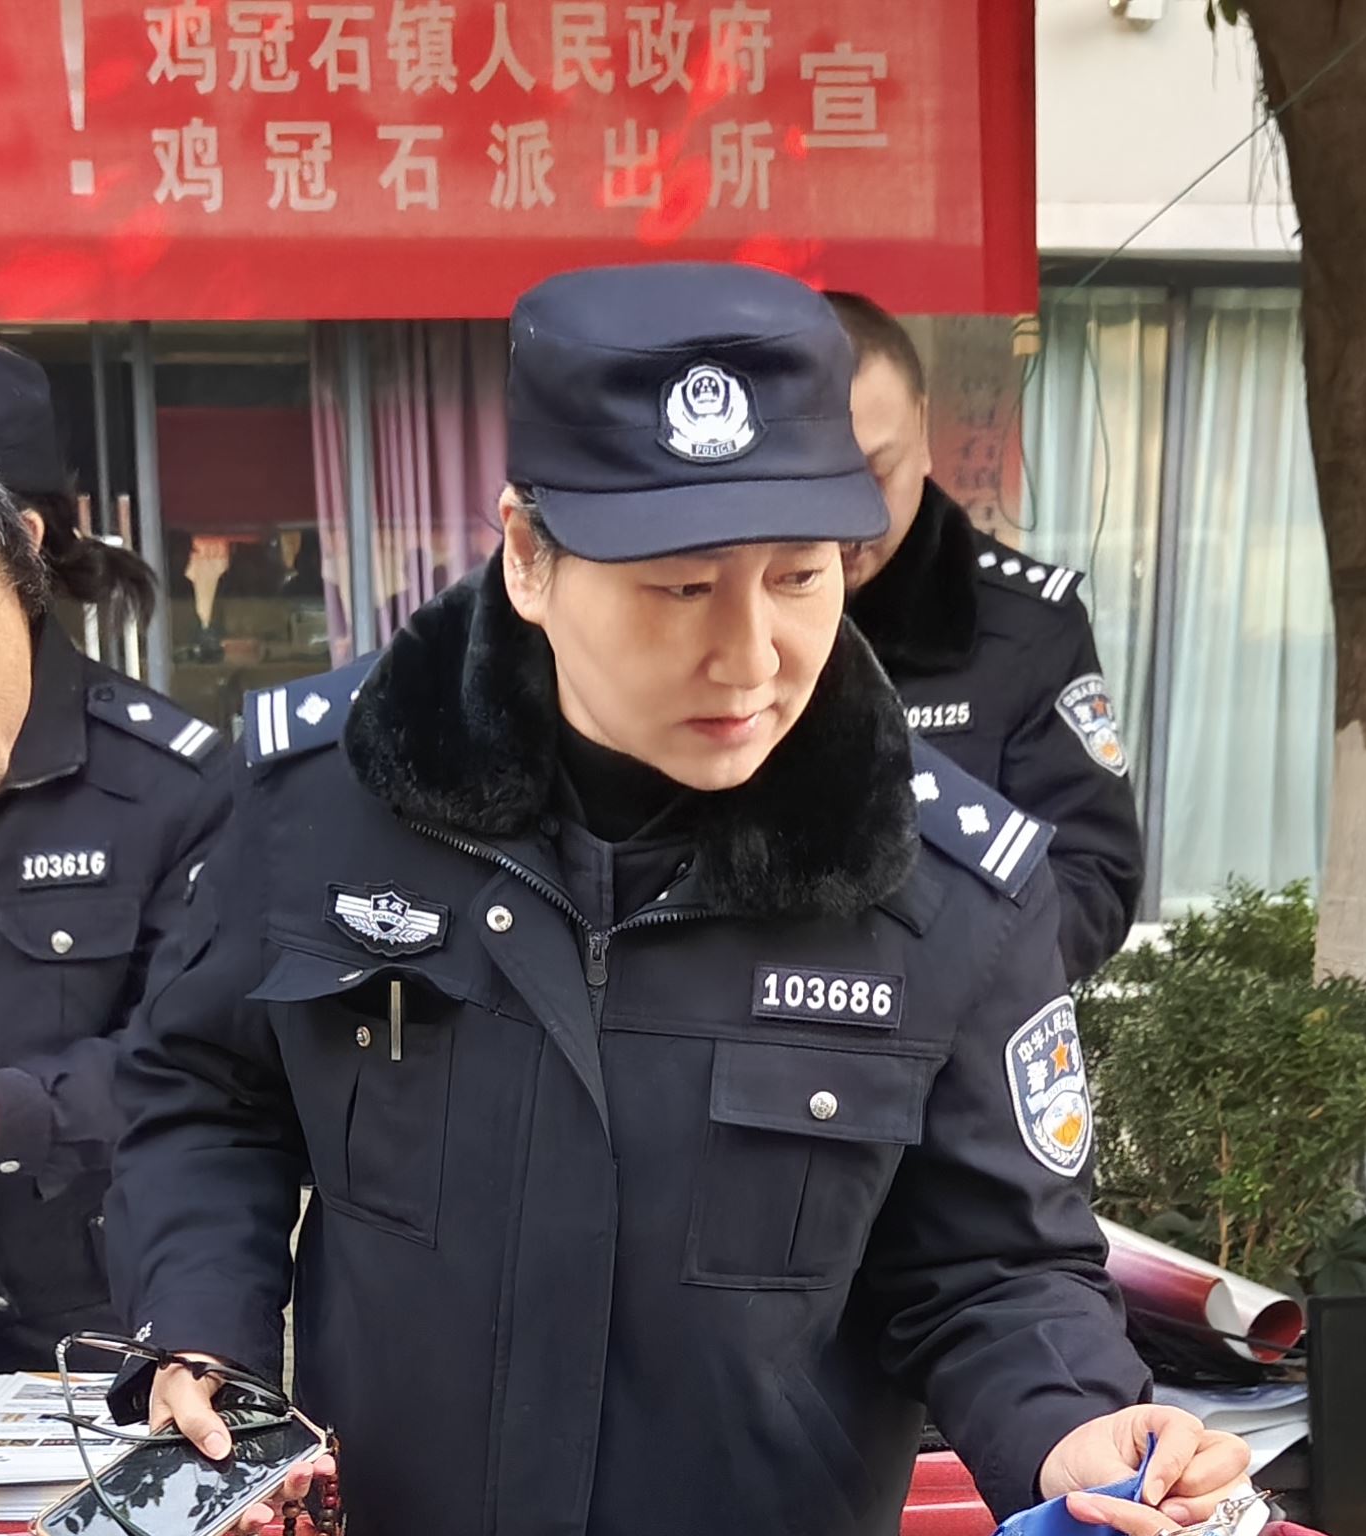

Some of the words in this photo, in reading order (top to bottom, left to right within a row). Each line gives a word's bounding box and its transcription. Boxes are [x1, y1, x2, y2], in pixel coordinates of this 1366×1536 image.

[145, 1, 775, 96] 鸡冠石镇人民政府
[799, 43, 889, 151] 宣
[152, 118, 776, 214] 鸡冠石派出所
[21, 851, 106, 881] 103616
[762, 973, 893, 1017] 103686
